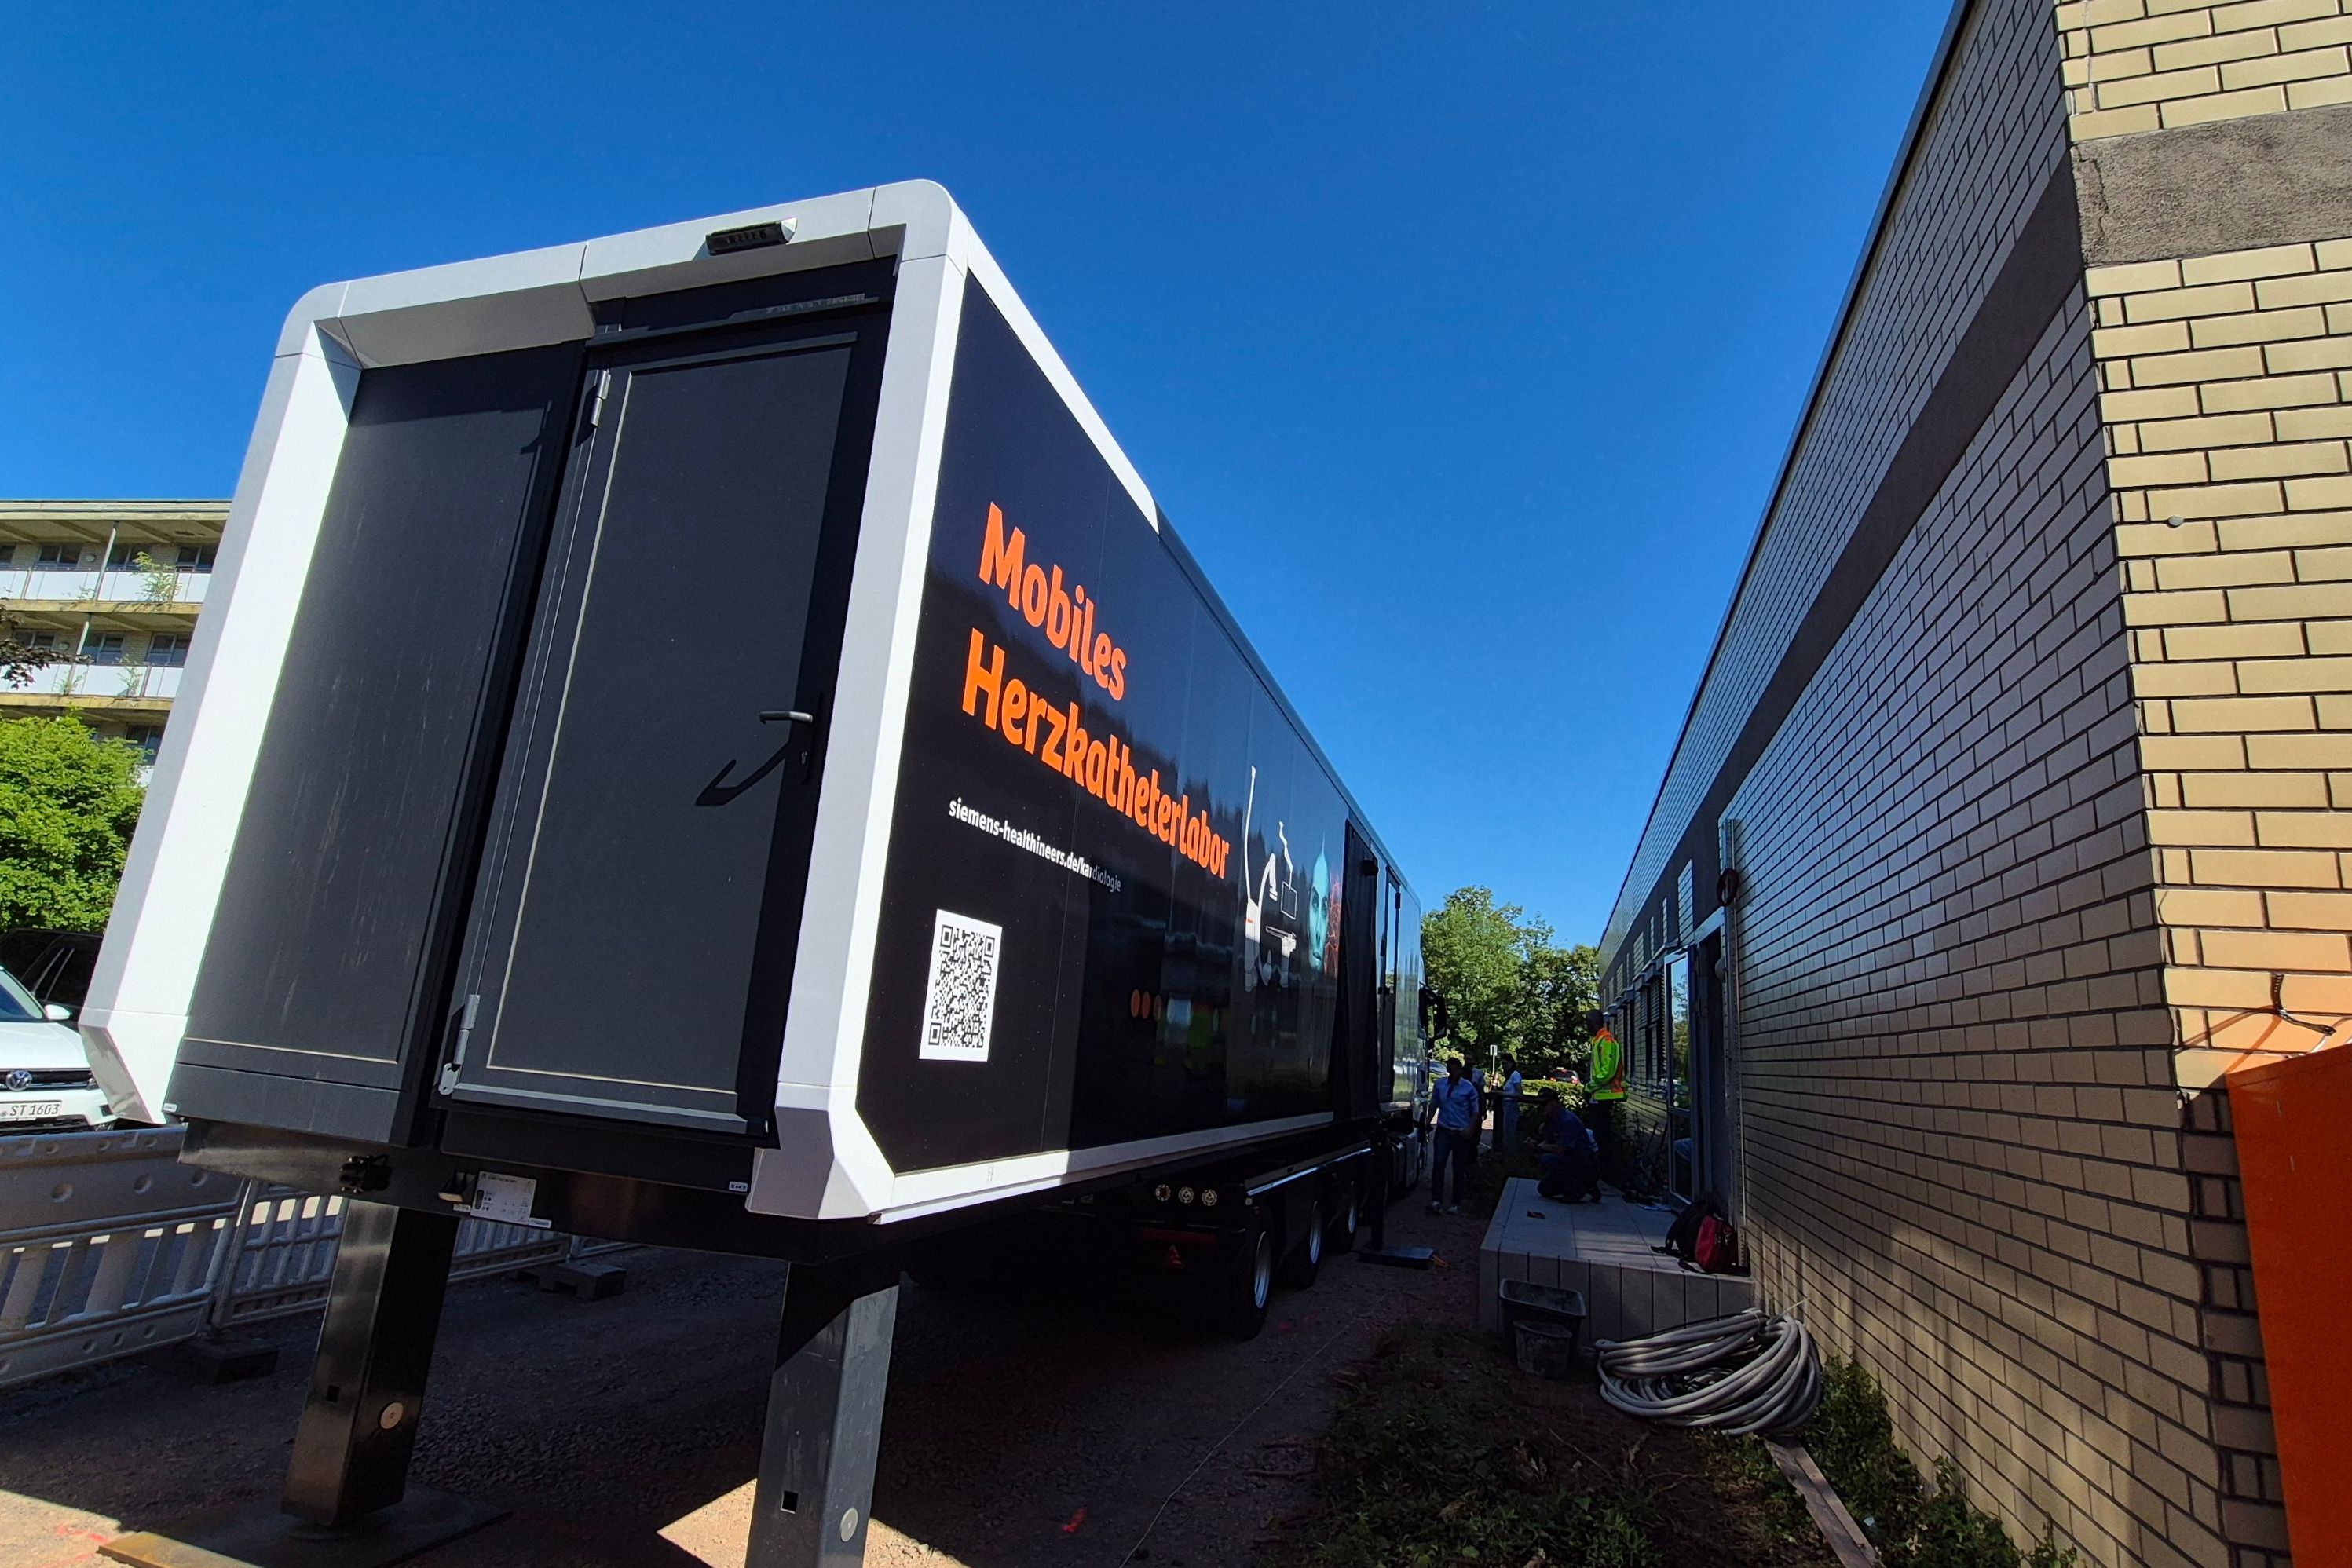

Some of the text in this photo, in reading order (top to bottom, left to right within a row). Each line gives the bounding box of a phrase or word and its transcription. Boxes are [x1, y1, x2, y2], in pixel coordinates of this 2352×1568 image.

[979, 502, 1128, 701] Mobiles
[949, 797, 1121, 893] siemens-healthineers.de/kardiologie
[962, 627, 1231, 879] Herzkatheterlabor
